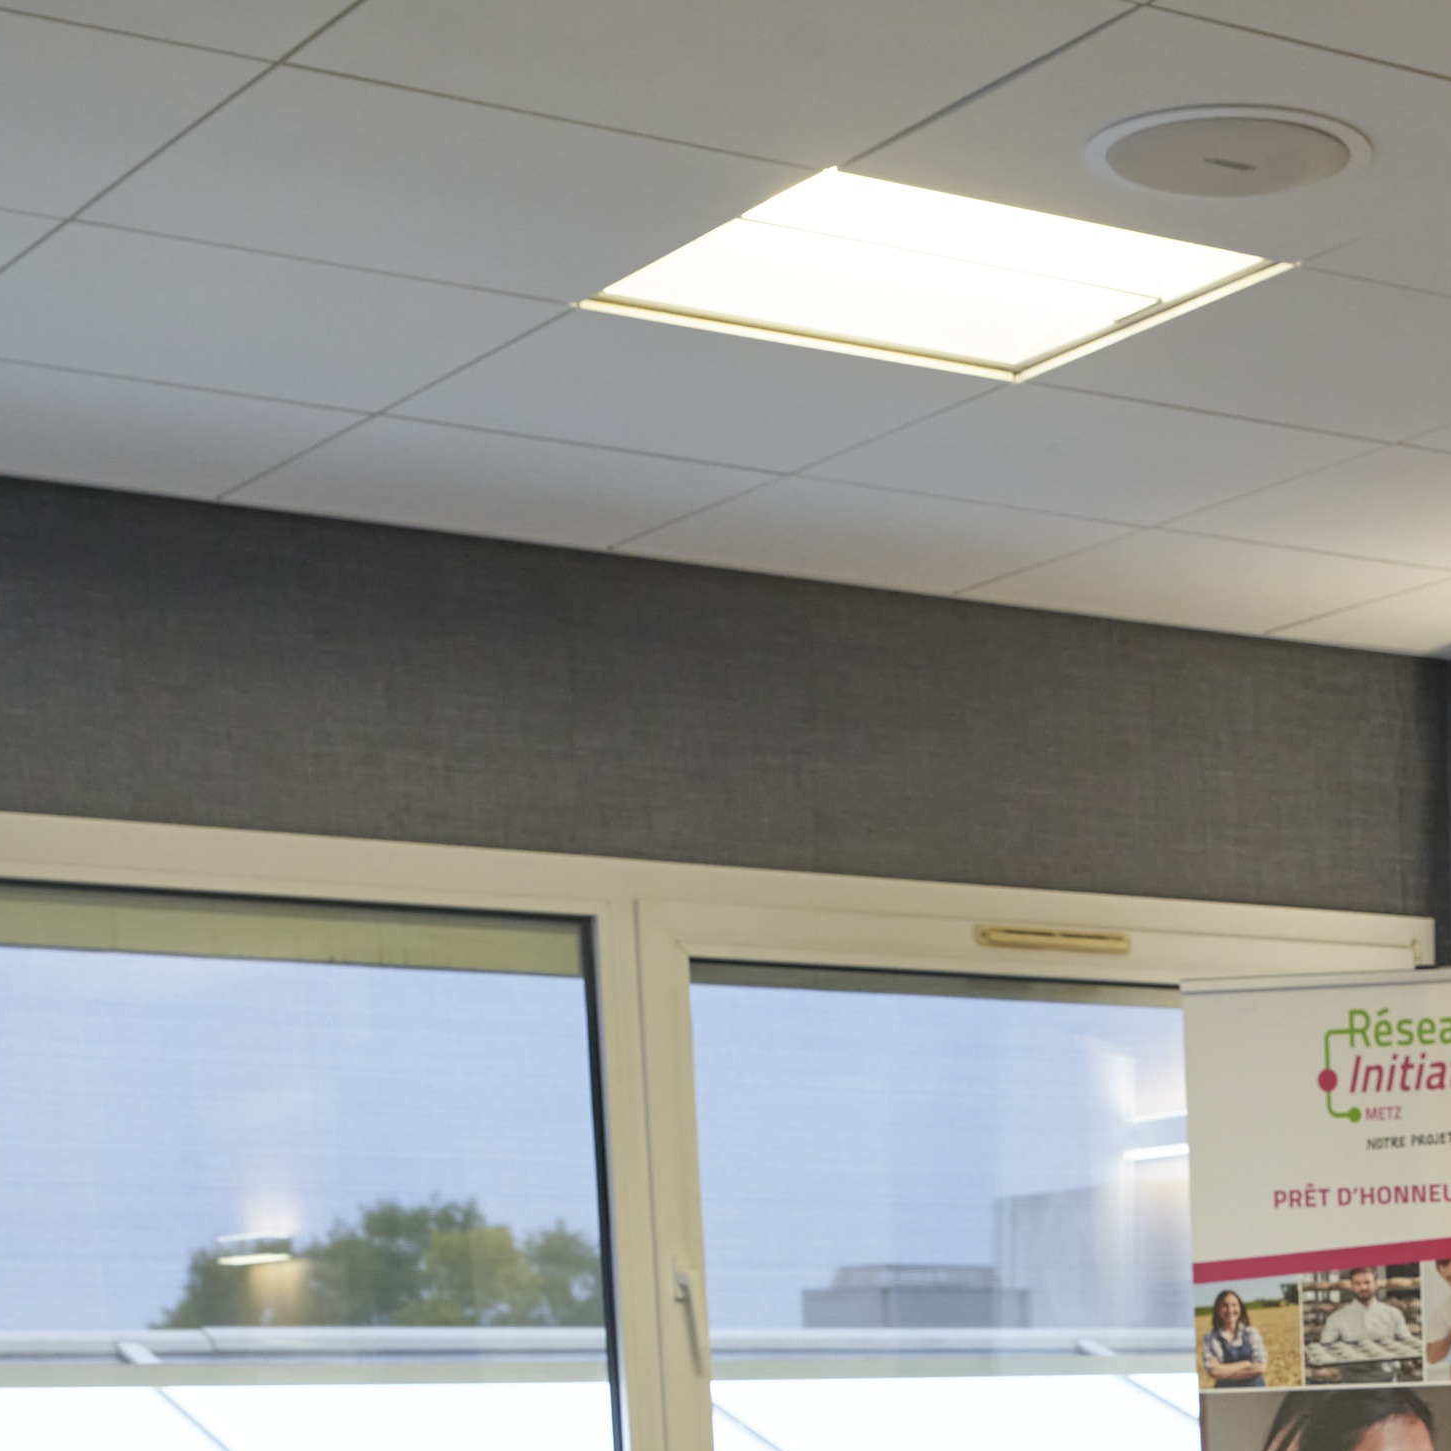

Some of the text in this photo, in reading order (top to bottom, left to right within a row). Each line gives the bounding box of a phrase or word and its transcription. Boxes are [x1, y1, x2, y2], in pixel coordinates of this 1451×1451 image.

[1365, 1106, 1402, 1120] METZ
[1366, 1136, 1405, 1151] NOTRE
[1273, 1183, 1330, 1209] PRÊT
